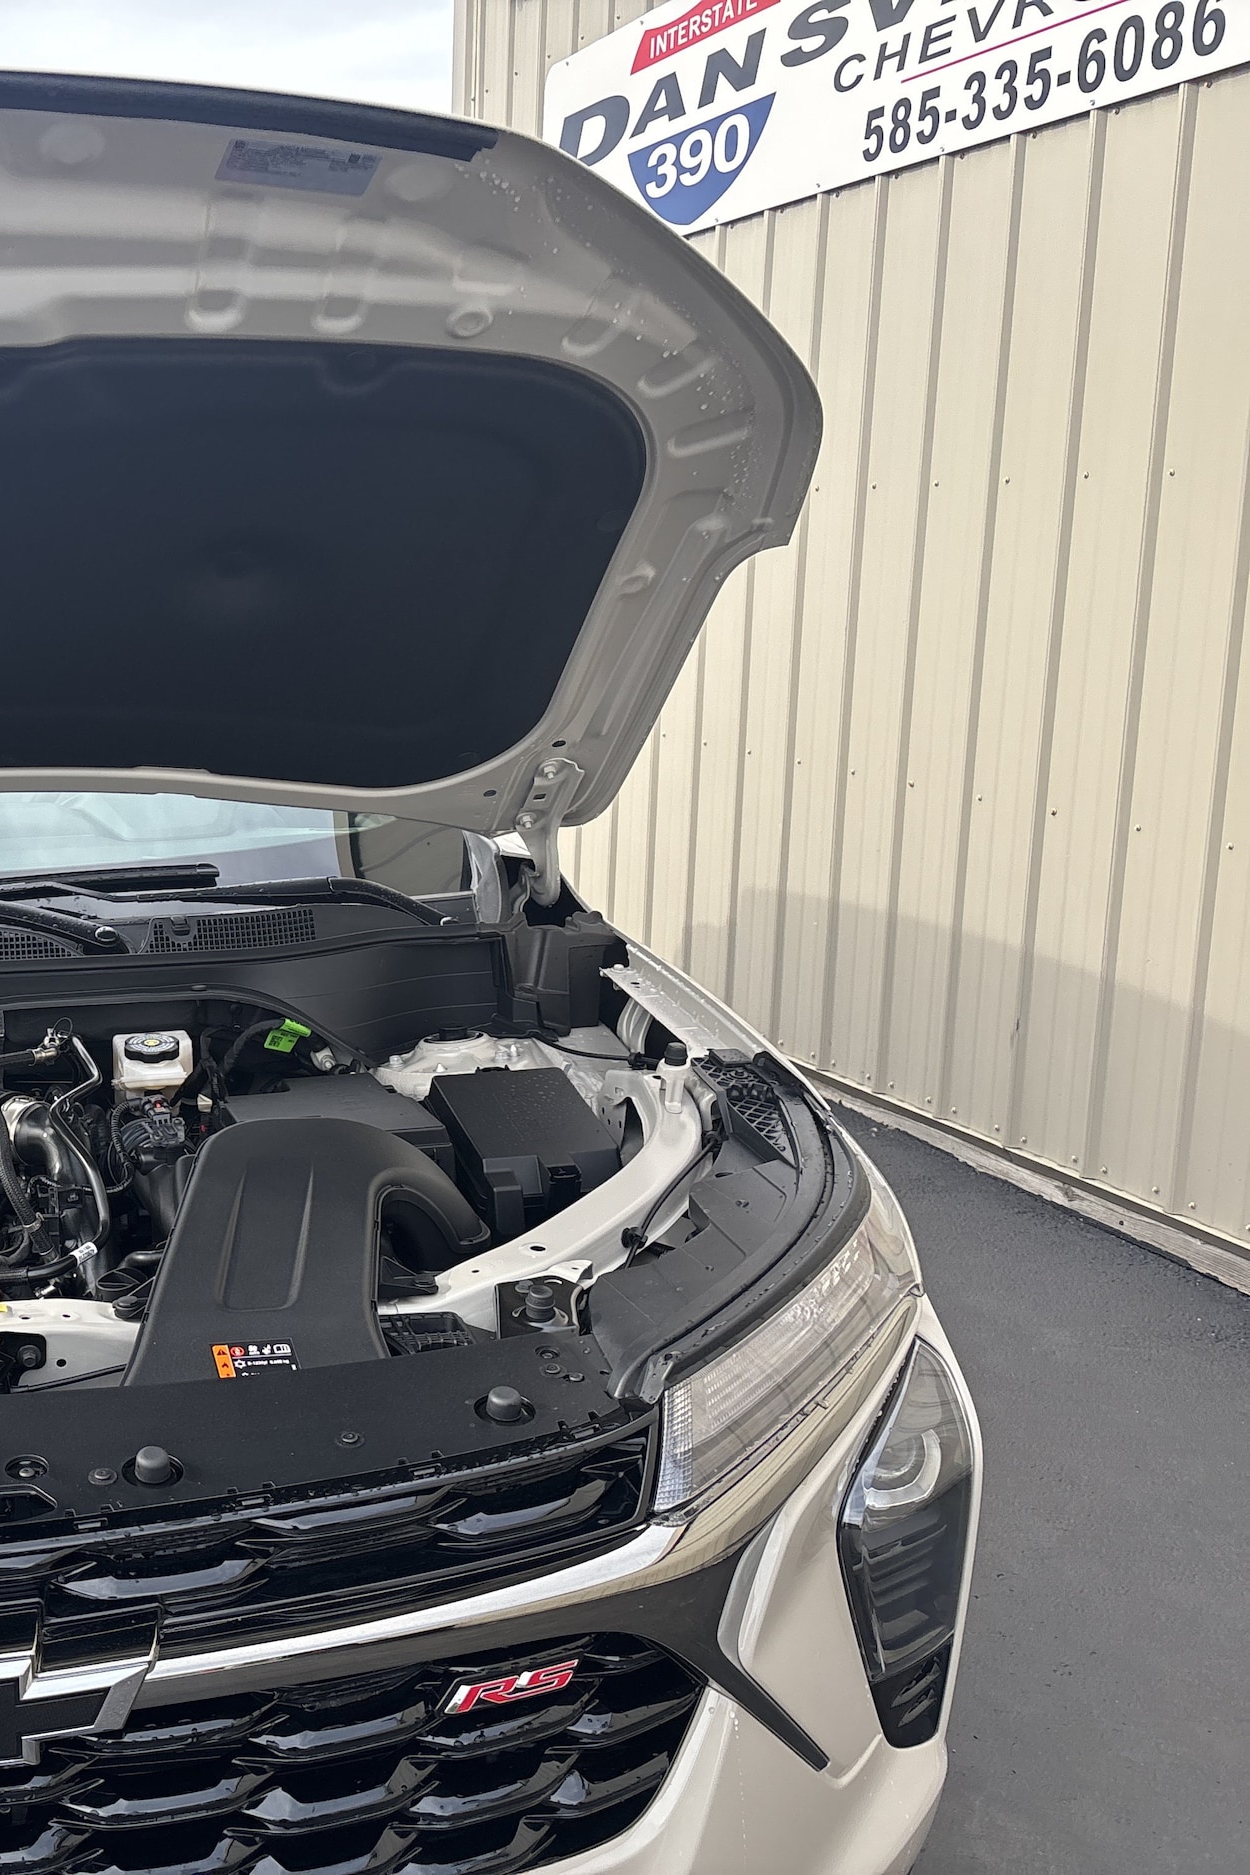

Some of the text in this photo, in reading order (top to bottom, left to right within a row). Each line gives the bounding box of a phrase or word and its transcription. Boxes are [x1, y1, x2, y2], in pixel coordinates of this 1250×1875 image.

[833, 0, 1094, 92] CHEVR
[862, 0, 1226, 162] 585-335-6086
[645, 113, 751, 199] 390
[444, 1659, 579, 1714] RS
